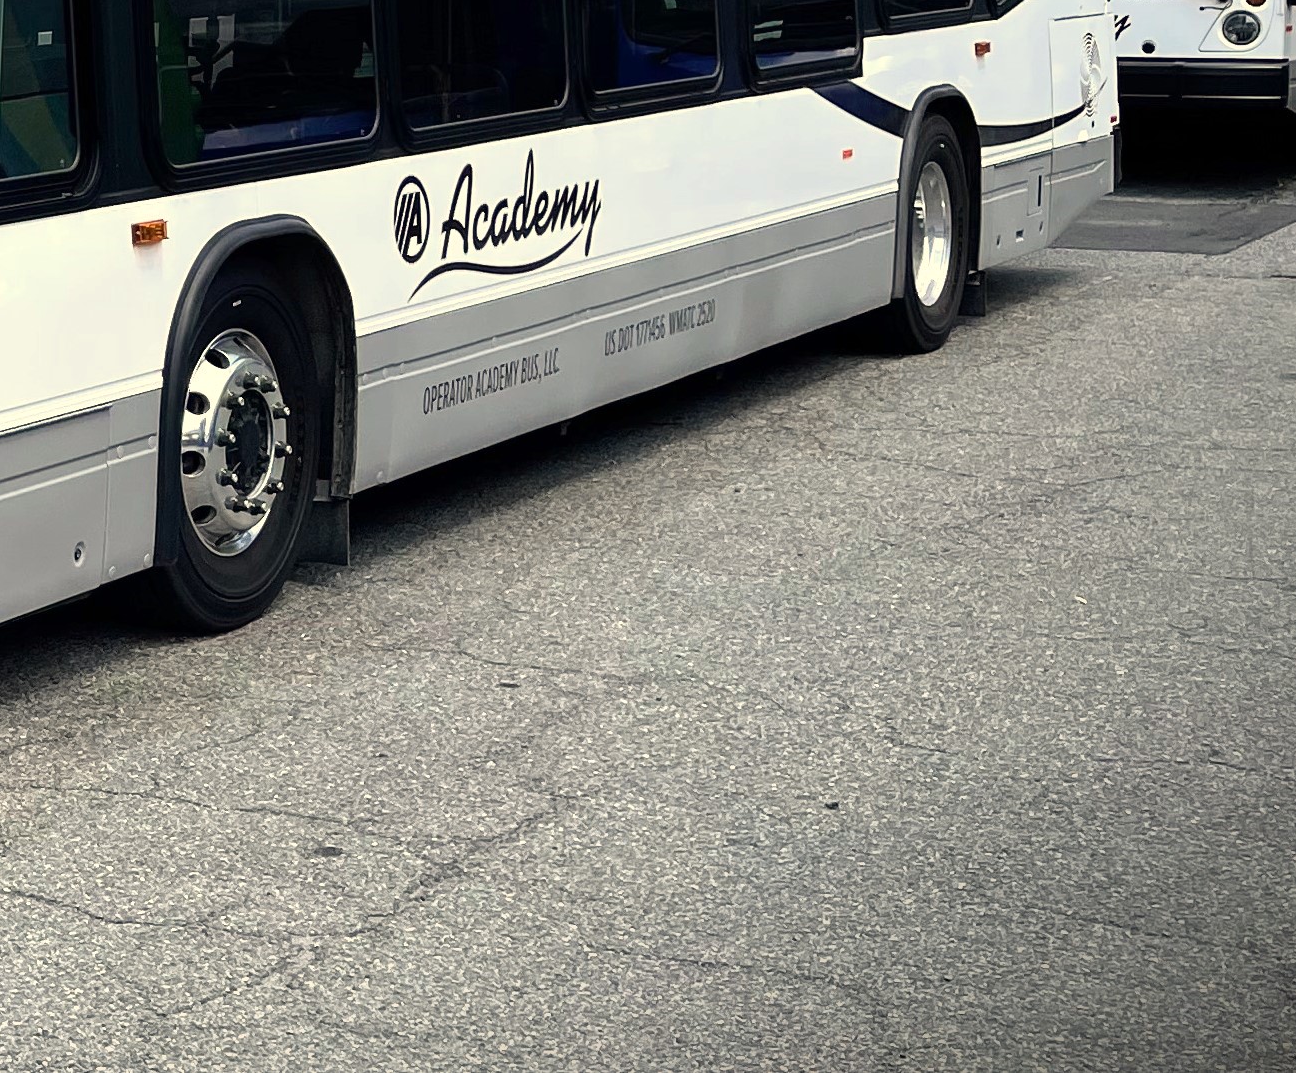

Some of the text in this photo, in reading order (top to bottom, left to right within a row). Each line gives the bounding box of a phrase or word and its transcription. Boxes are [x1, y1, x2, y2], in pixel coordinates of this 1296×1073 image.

[440, 148, 602, 257] Academy
[618, 324, 635, 352] DOT
[422, 347, 560, 415] OPERATOR ACADEMY BUS, LLC
